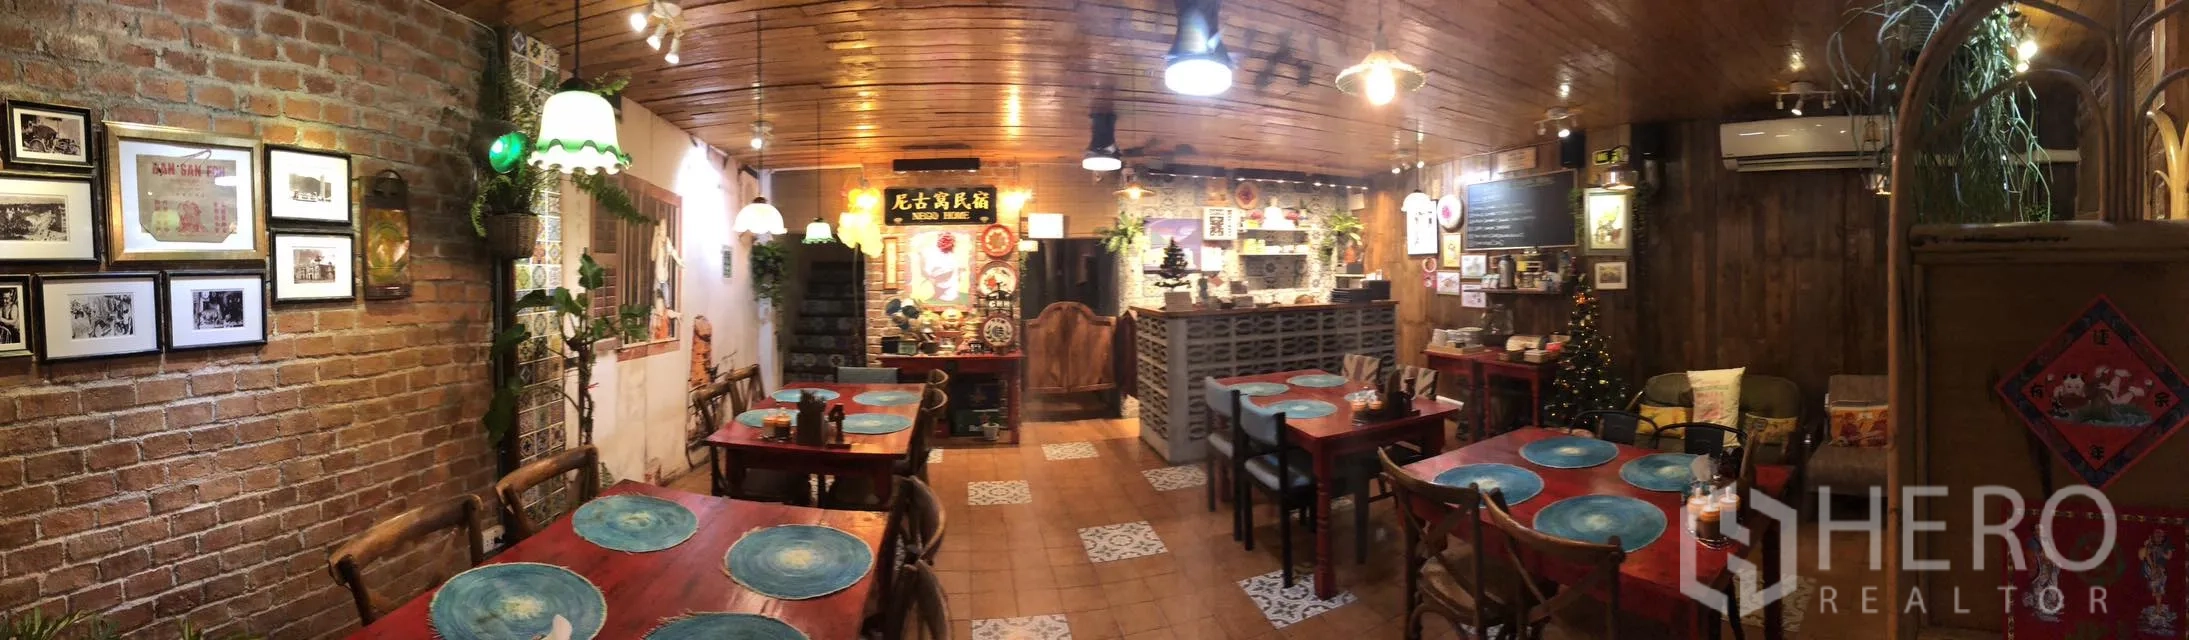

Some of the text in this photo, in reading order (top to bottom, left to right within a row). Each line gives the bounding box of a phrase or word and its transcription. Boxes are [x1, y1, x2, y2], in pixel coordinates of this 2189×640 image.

[180, 163, 201, 176] SAN
[891, 190, 990, 210] 尼古窩民宿
[943, 211, 970, 220] HOME
